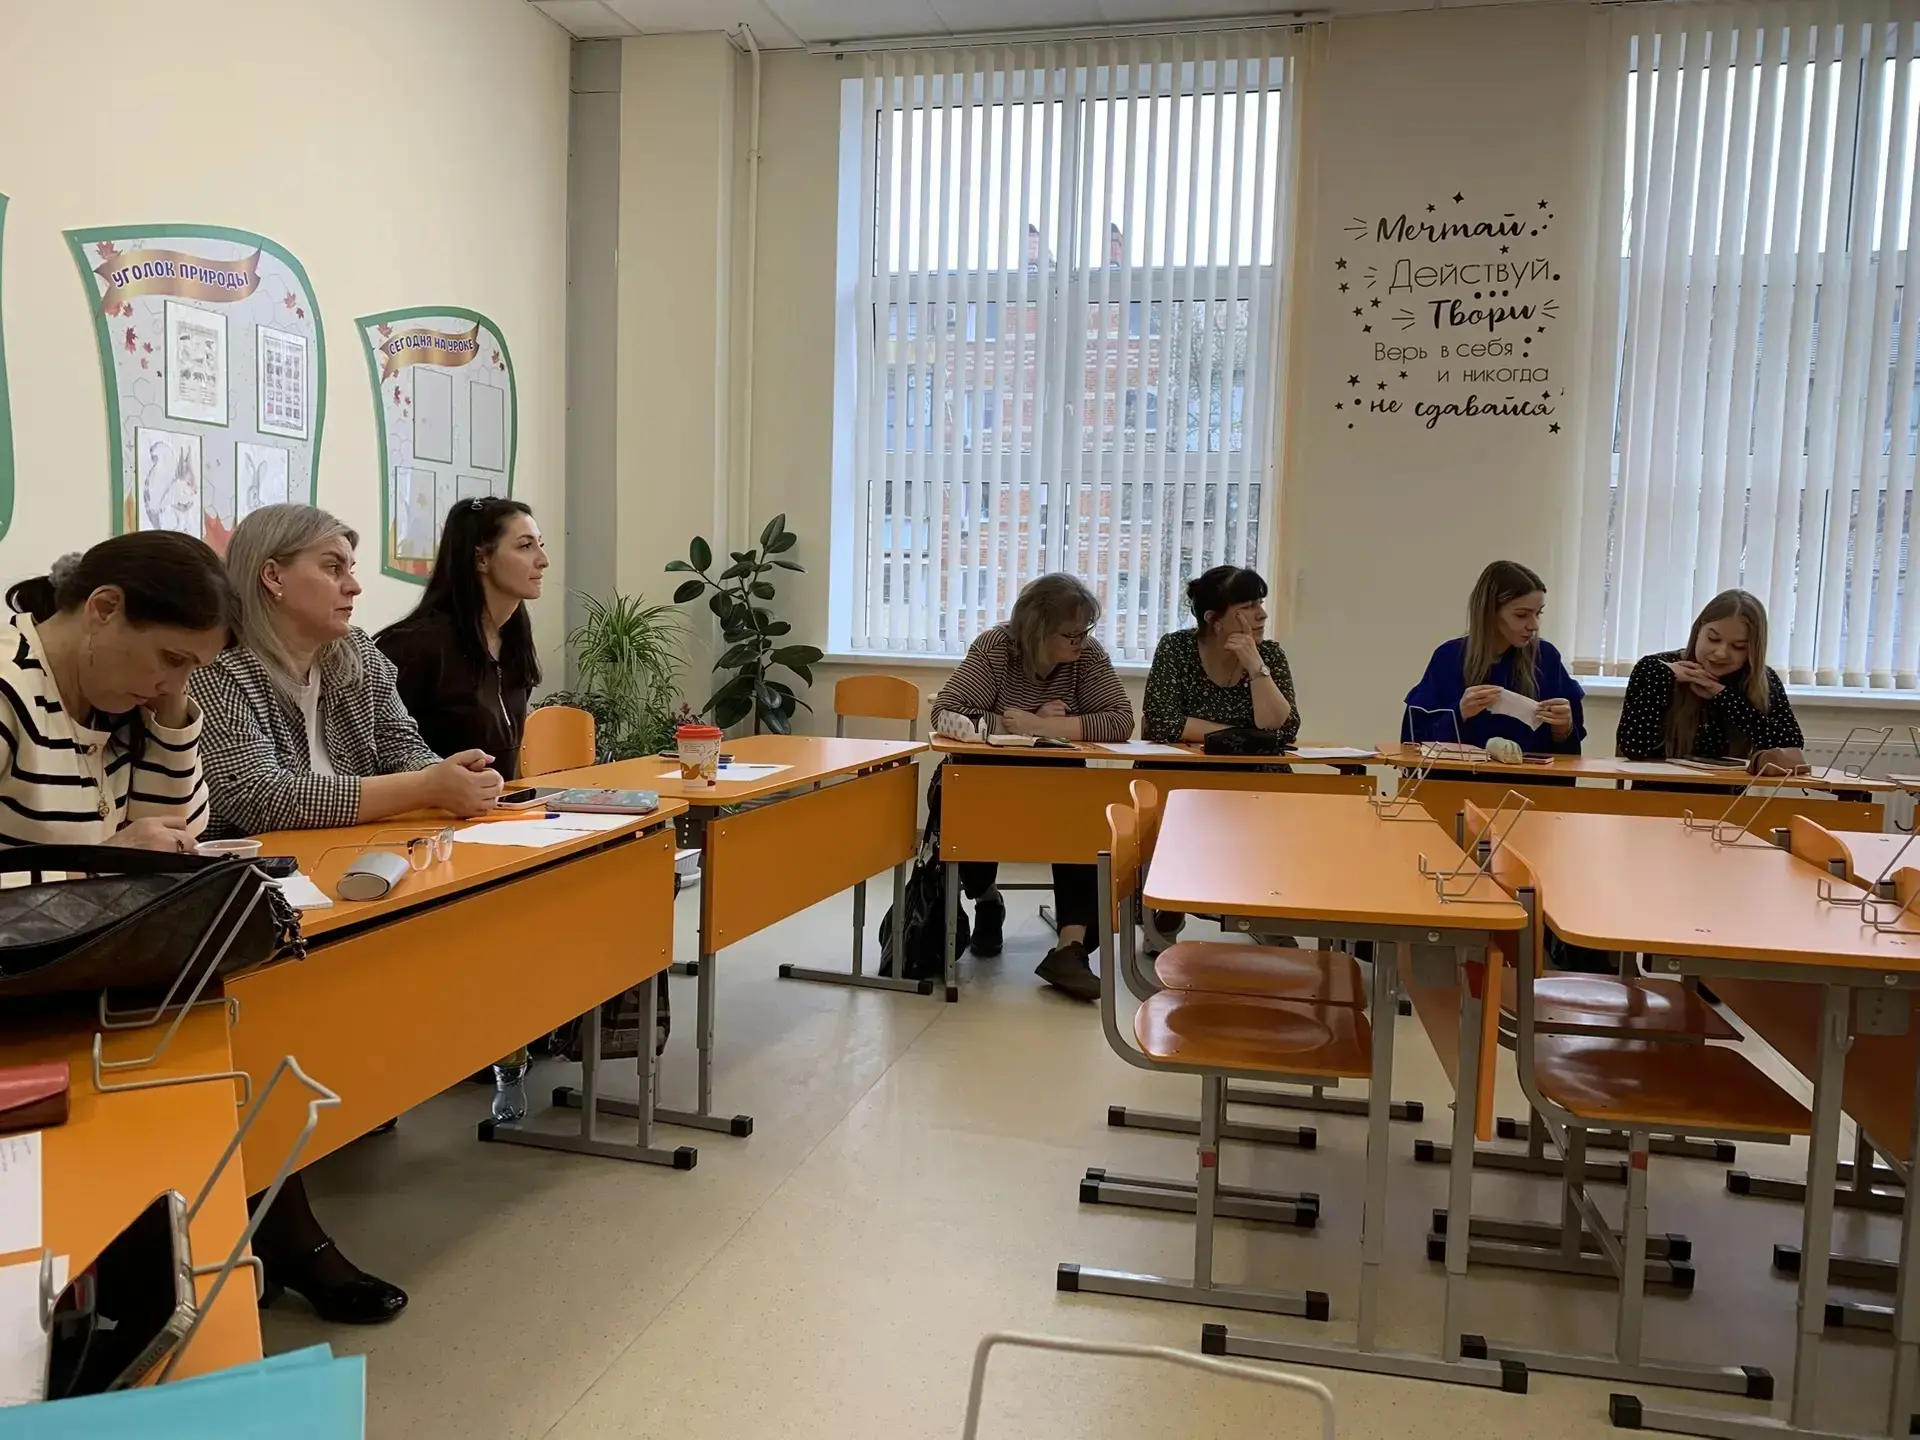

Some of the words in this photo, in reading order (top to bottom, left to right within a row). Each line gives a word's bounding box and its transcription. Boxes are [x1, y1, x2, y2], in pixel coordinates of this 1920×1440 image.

[112, 261, 175, 288] УГОЛОК
[179, 263, 250, 289] ПРИРОДЫ
[1428, 299, 1537, 333] Твори
[389, 335, 432, 355] СЕГОДНЯ
[434, 337, 446, 349] НА
[448, 338, 474, 352] УРОКЕ
[1375, 342, 1428, 364] Верь
[1440, 345, 1450, 359] в
[1456, 338, 1514, 358] себя
[1437, 370, 1450, 383] и
[1463, 368, 1549, 384] никогда
[1370, 398, 1404, 414] не
[1414, 394, 1556, 430] сдавайся
